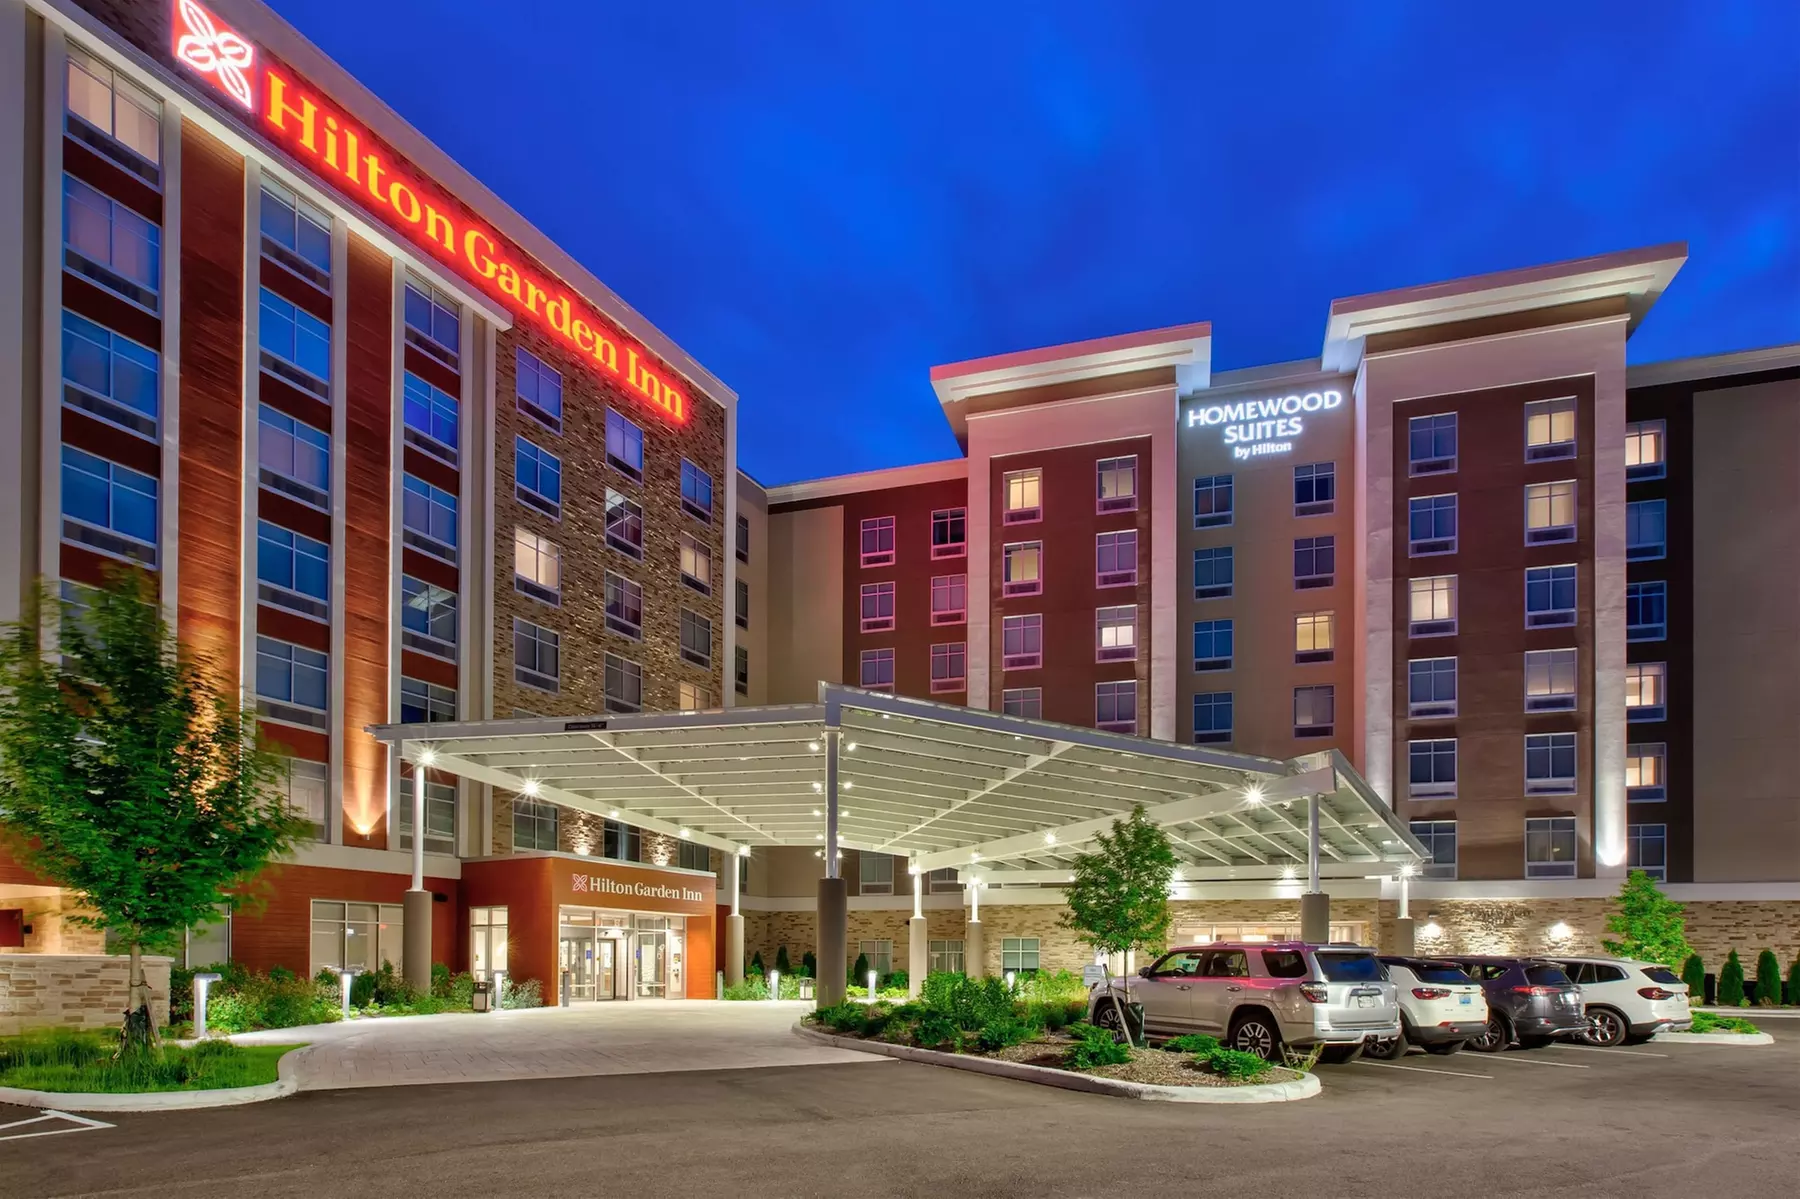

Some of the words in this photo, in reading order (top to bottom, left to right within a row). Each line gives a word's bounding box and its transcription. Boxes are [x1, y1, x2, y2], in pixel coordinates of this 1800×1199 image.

[266, 71, 456, 254] Hilton
[463, 227, 620, 374] Garden
[626, 347, 685, 421] Inn
[1187, 390, 1342, 427] HOMEWOOD
[1224, 417, 1303, 444] SUITES
[1234, 446, 1251, 460] by
[1252, 442, 1293, 455] Hilton
[590, 877, 633, 895] Hilton
[635, 882, 680, 900] Garden
[682, 887, 703, 901] Inn
